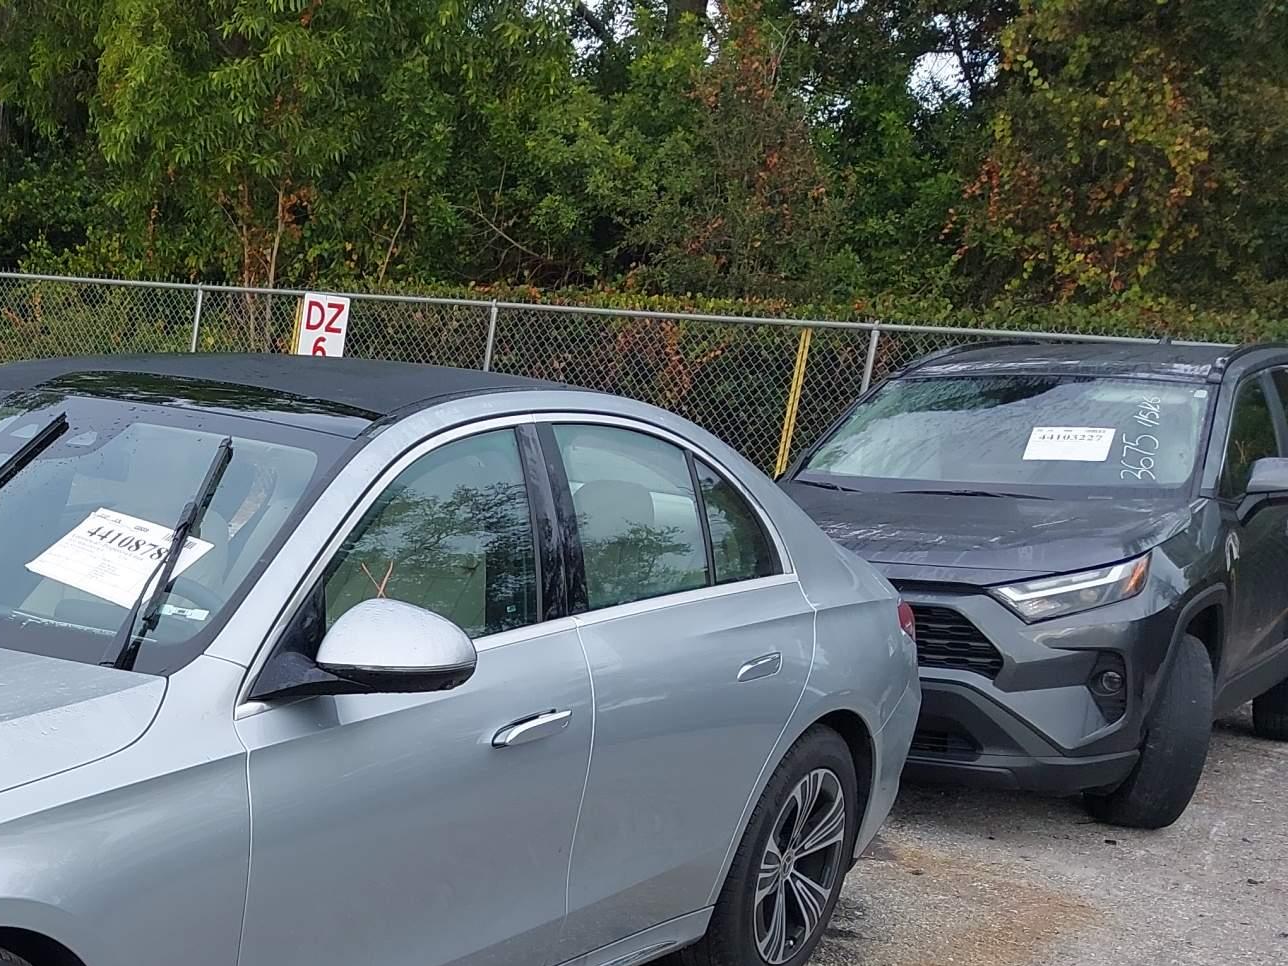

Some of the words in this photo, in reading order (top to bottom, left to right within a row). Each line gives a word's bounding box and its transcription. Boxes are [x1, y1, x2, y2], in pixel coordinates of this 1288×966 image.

[306, 300, 345, 333] DZ
[1038, 434, 1104, 442] 44103227
[1120, 433, 1159, 480] 3675
[87, 526, 170, 561] 4410878
